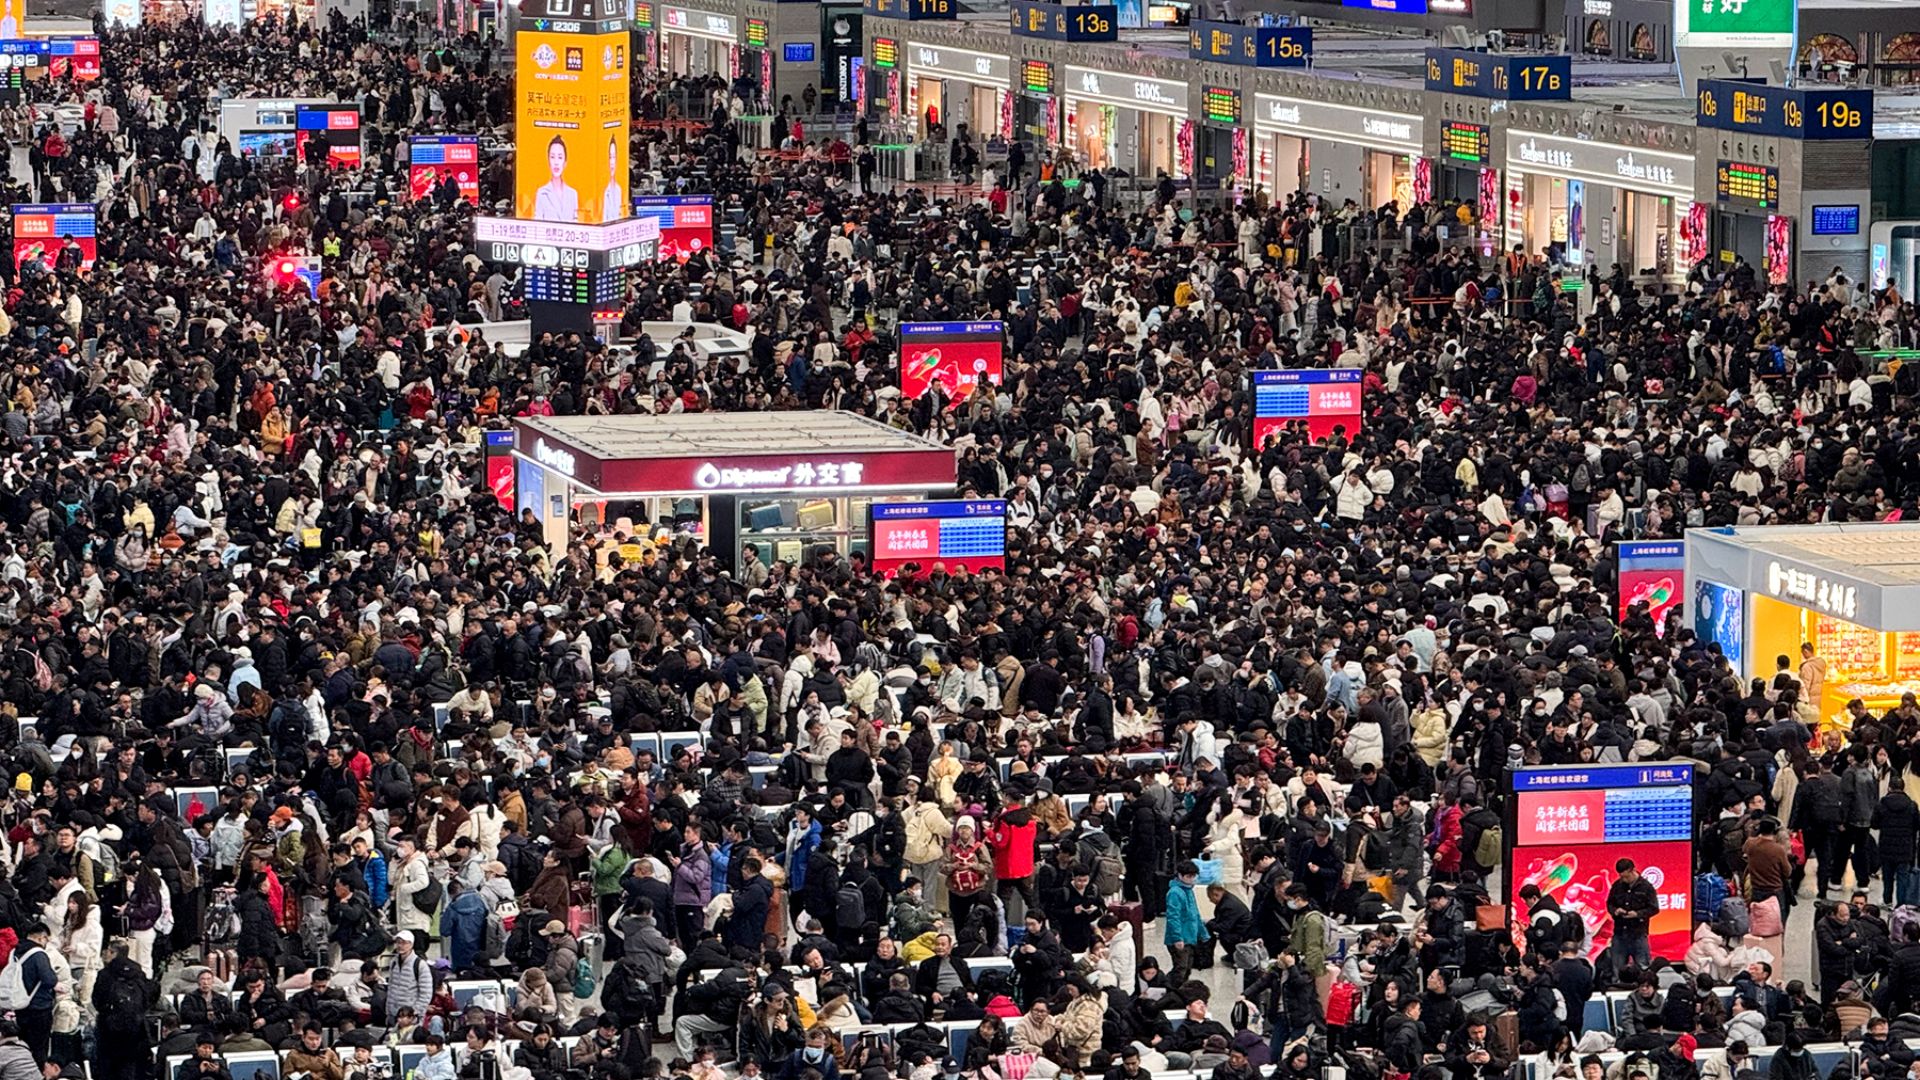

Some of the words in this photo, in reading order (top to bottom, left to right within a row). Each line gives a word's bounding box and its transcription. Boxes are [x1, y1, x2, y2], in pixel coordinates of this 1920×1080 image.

[918, 0, 949, 13] 11B
[553, 21, 580, 32] 12306
[1076, 13, 1109, 33] 13B
[1244, 36, 1256, 58] 15B
[1267, 37, 1303, 58] 15B
[1426, 58, 1440, 81] 16B
[1493, 66, 1508, 90] 17B
[1520, 67, 1560, 91] 17B
[1134, 82, 1161, 102] ERDOS
[1699, 90, 1717, 116] 18B
[1783, 100, 1802, 127] 19B
[1816, 101, 1861, 127] 19B
[795, 462, 864, 486] 外交官
[1535, 805, 1589, 821] 马年新春至
